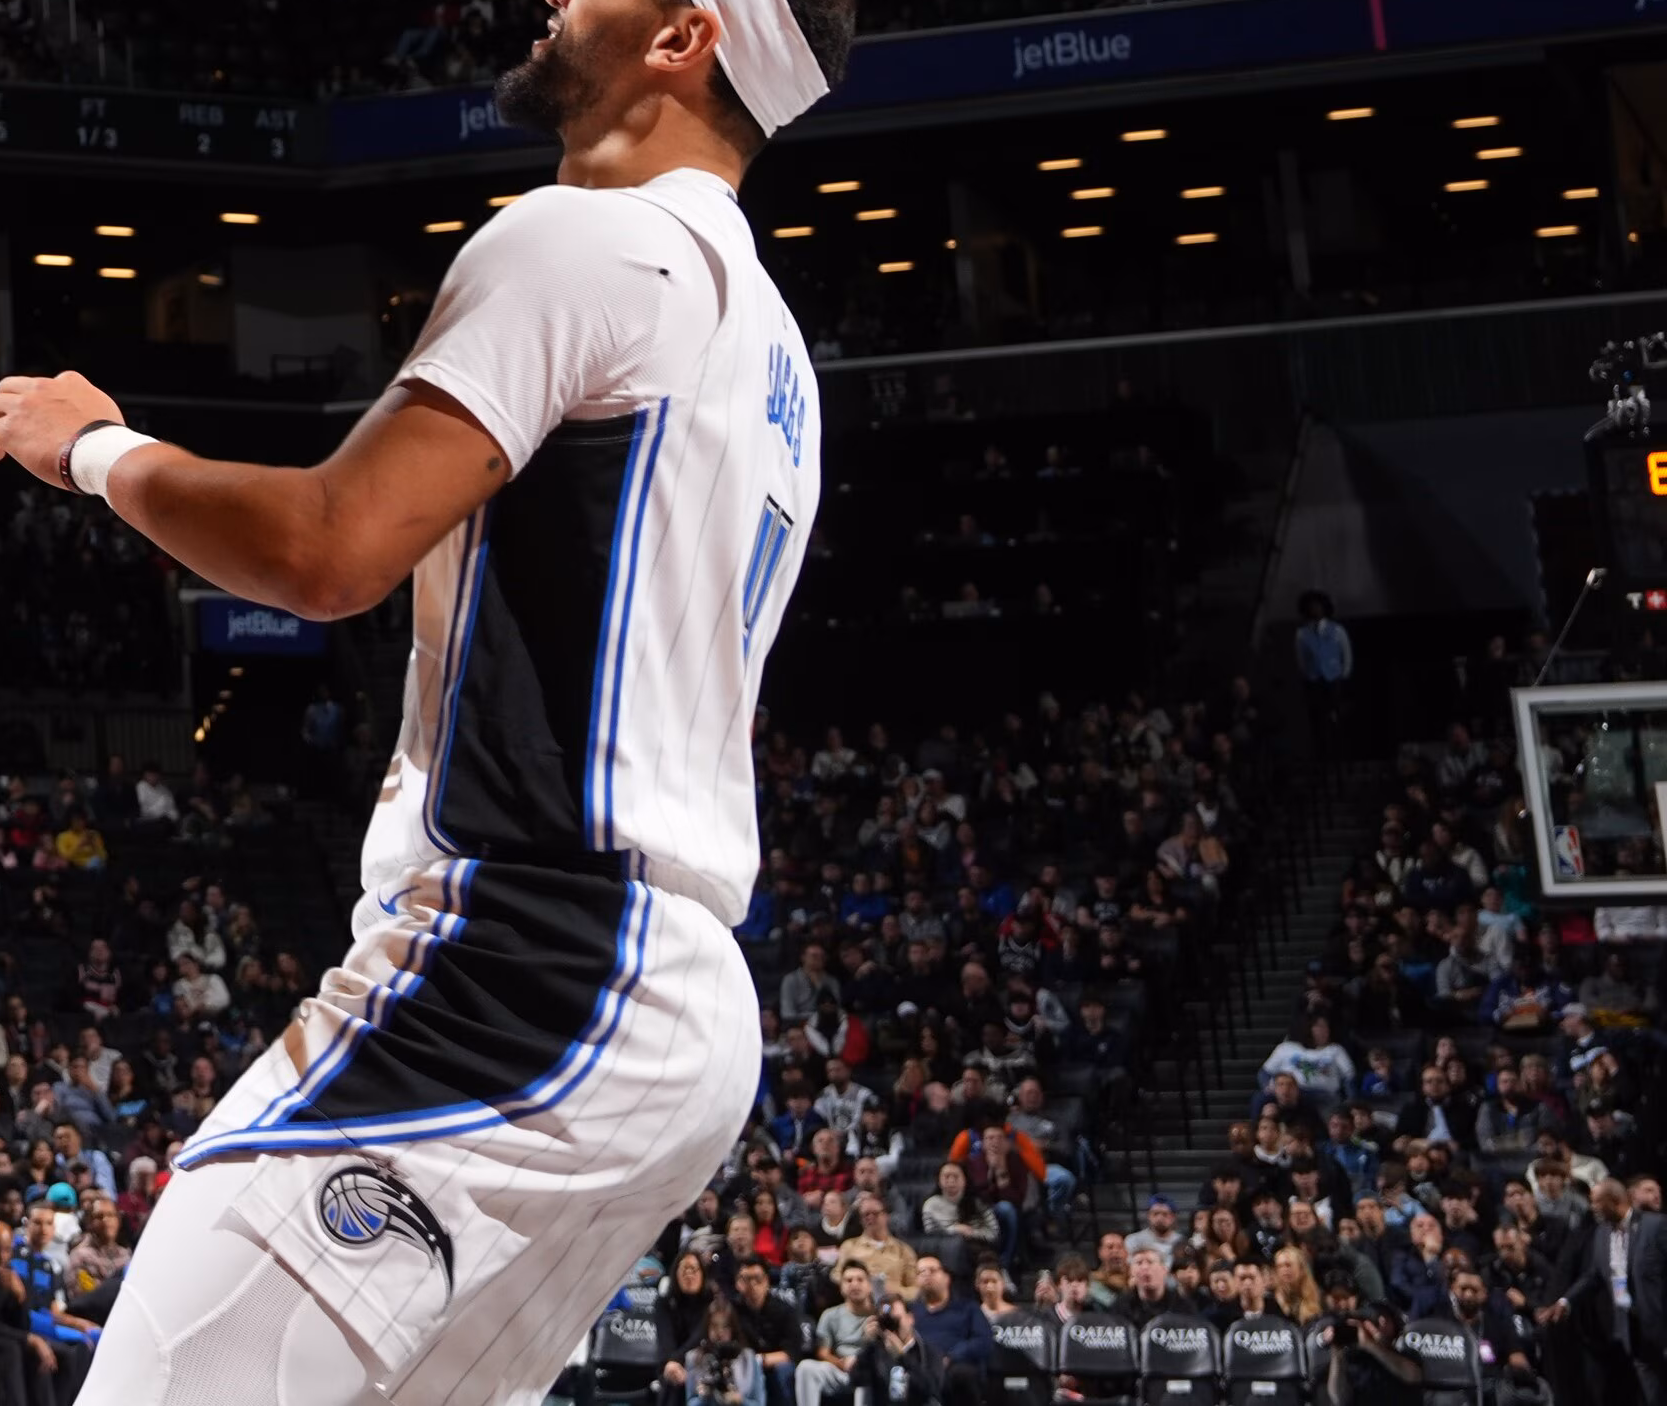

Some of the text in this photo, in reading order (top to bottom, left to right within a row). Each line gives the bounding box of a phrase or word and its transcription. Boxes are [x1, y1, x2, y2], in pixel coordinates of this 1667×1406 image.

[1013, 31, 1130, 81] jetBlue
[255, 108, 299, 132] AST
[227, 609, 300, 642] jetBlue
[990, 1325, 1044, 1342] QATAR
[1069, 1325, 1126, 1343] QATAR
[1150, 1327, 1208, 1346] QATAR
[1234, 1329, 1292, 1348] QATAR
[1404, 1331, 1465, 1351] QATAR
